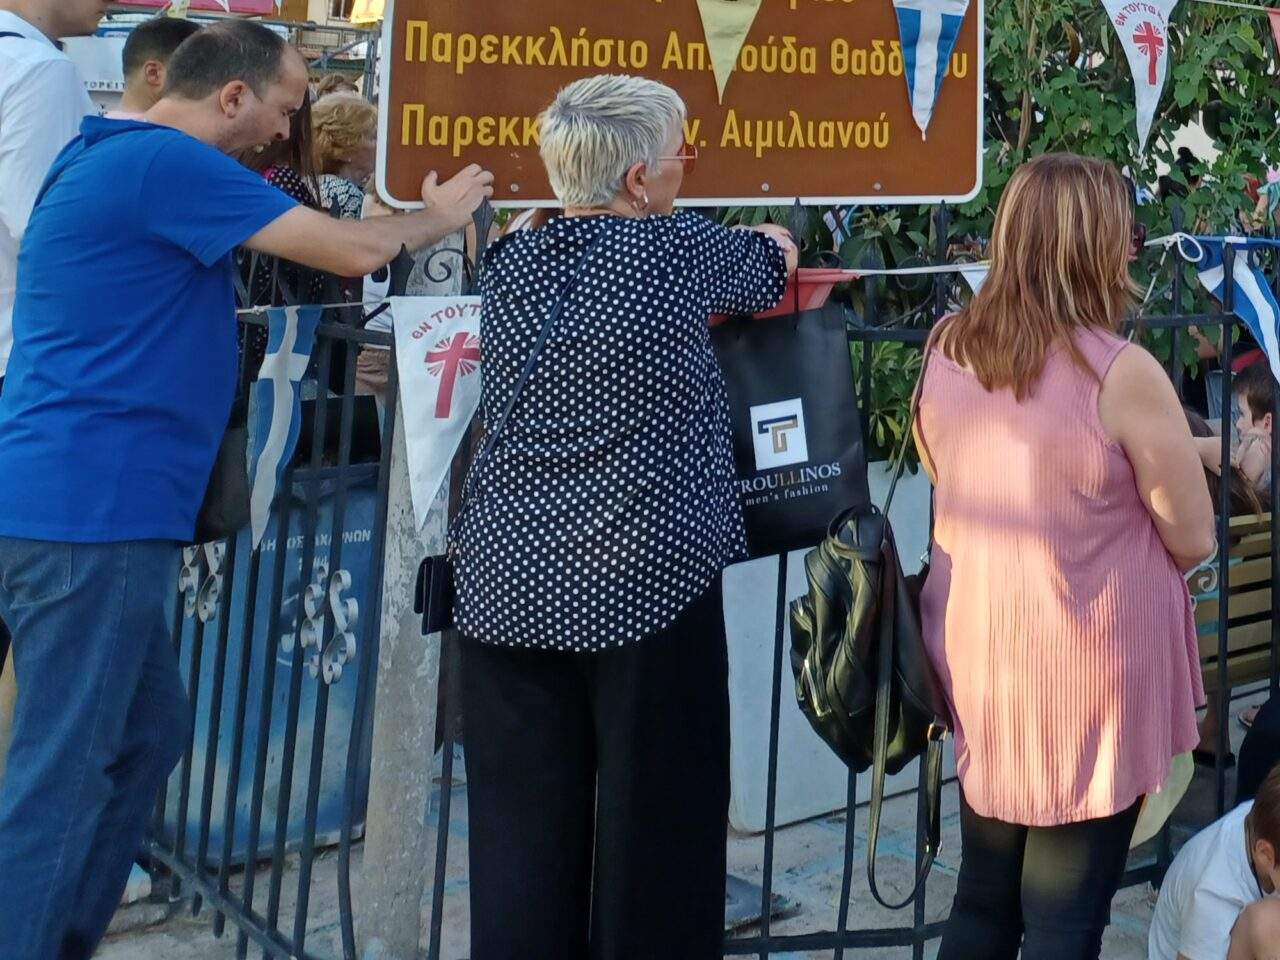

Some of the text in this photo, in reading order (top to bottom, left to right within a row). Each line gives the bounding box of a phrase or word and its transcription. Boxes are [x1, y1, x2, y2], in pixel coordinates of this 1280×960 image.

[405, 20, 649, 74] Παρεκκλήσιο
[732, 36, 817, 75] ούδα
[831, 38, 968, 79] Θαδδυ
[401, 104, 542, 157] Παρεκκ
[720, 109, 890, 158] Αιμιλιανού
[431, 303, 482, 324] ΤΟΥΤ
[738, 462, 842, 494] ROULLINOS
[745, 483, 829, 506] men's fashion
